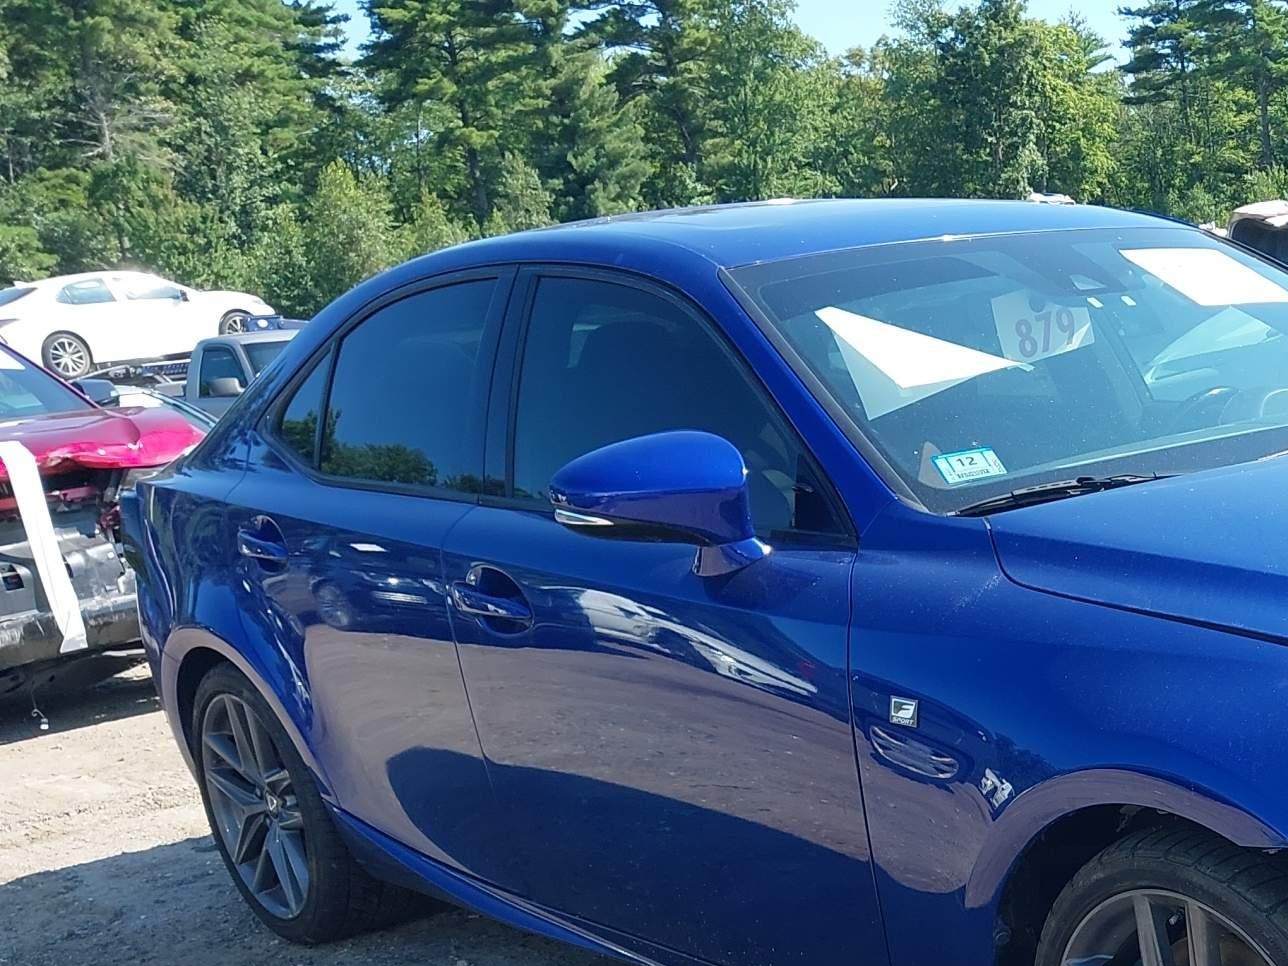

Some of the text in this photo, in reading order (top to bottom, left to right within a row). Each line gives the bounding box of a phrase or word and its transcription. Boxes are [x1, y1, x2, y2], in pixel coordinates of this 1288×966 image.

[1015, 309, 1075, 358] 879
[956, 456, 978, 467] 12
[892, 716, 914, 725] SPORT
